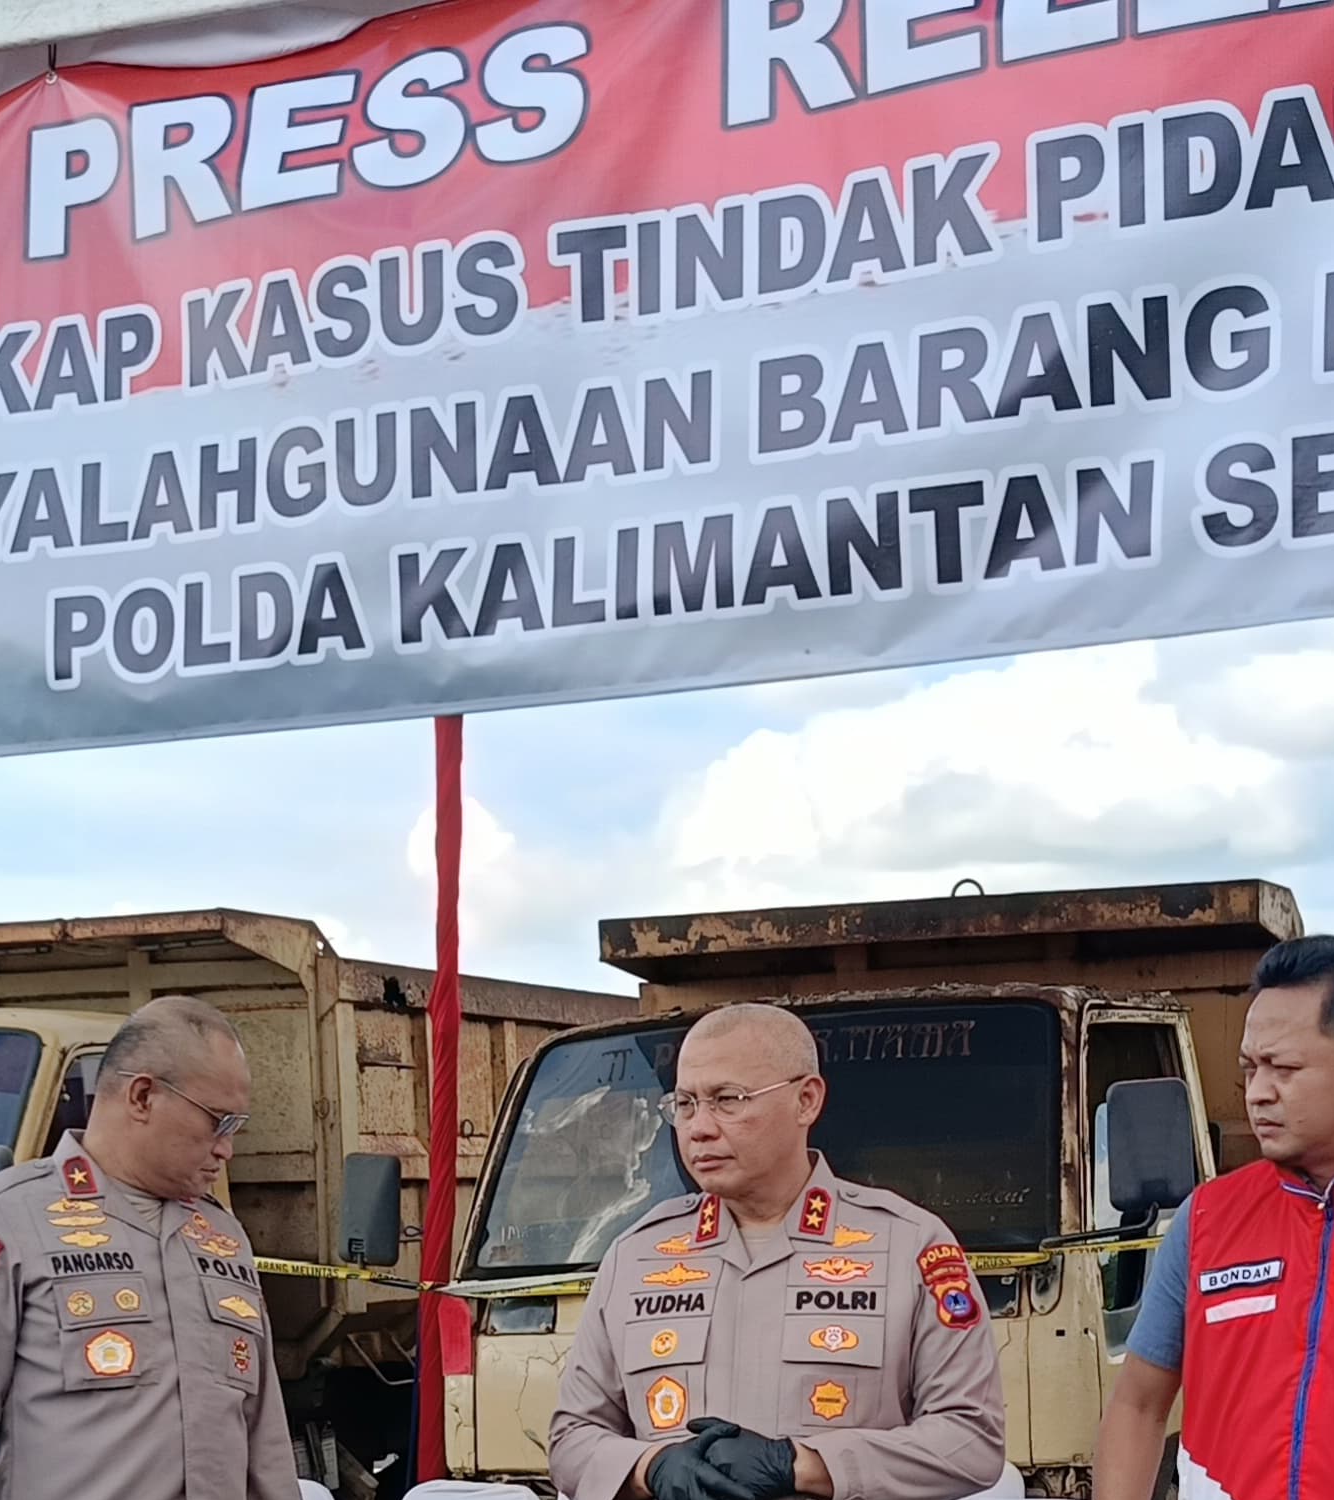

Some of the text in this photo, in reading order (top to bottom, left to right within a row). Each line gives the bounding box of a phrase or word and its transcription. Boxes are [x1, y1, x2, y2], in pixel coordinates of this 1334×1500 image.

[24, 21, 589, 261] PRESS
[187, 240, 519, 389] KASUS
[557, 152, 993, 324] TINDAK
[757, 284, 1271, 455] BARANG
[53, 561, 366, 681] POLDA
[398, 460, 1155, 645] KALIMANTAN
[52, 1251, 258, 1288] PANGARSO POLRI
[256, 1261, 289, 1273] ARANG
[920, 1246, 961, 1270] POLDA
[1208, 1266, 1272, 1287] BONDAN
[633, 1290, 877, 1317] YUDHA POLRI
